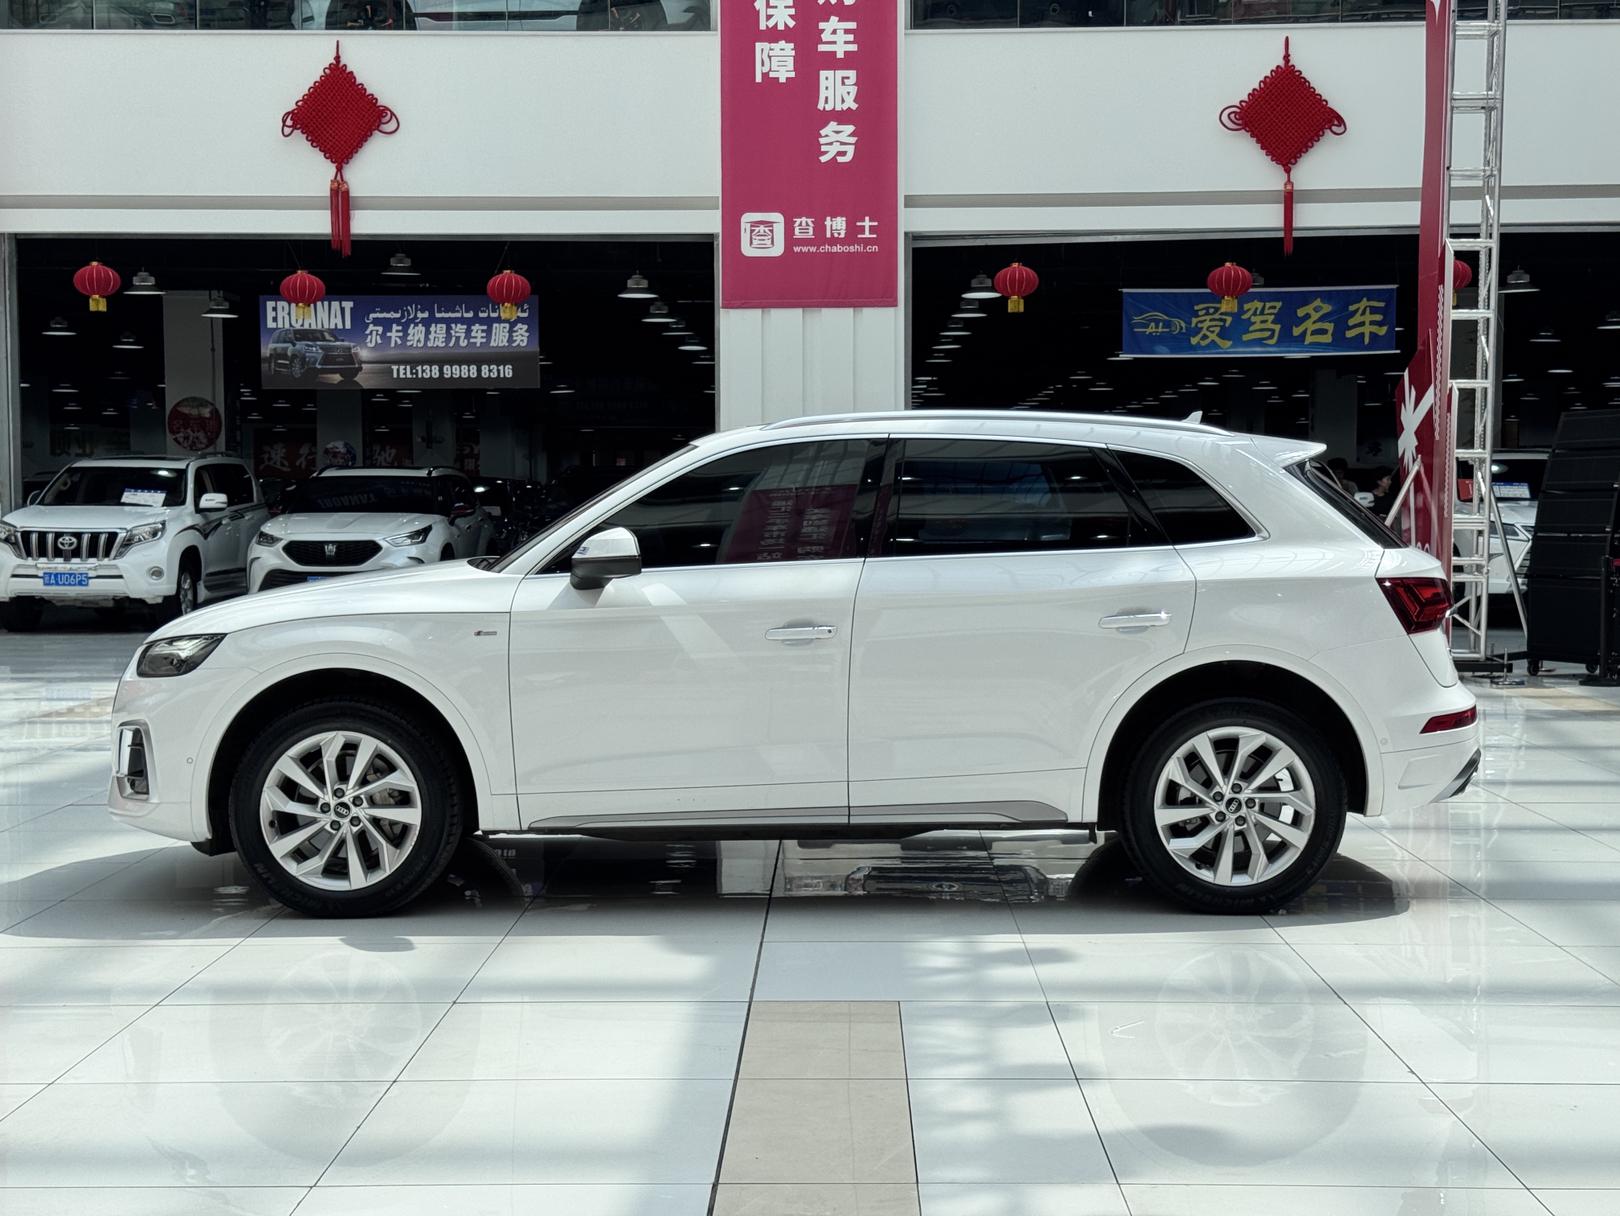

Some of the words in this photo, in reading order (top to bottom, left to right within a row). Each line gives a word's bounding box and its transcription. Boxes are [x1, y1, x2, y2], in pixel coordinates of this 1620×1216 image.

[817, 0, 859, 163] 车服务
[793, 216, 878, 238] 查博士
[793, 244, 878, 253] www.chaboshi.cn
[1190, 297, 1390, 349] 爱驾名车
[364, 323, 530, 348] 尔卡纳提汽车服务
[391, 365, 439, 378] TEL:138
[443, 365, 477, 378] 9988
[481, 365, 513, 378] 8316
